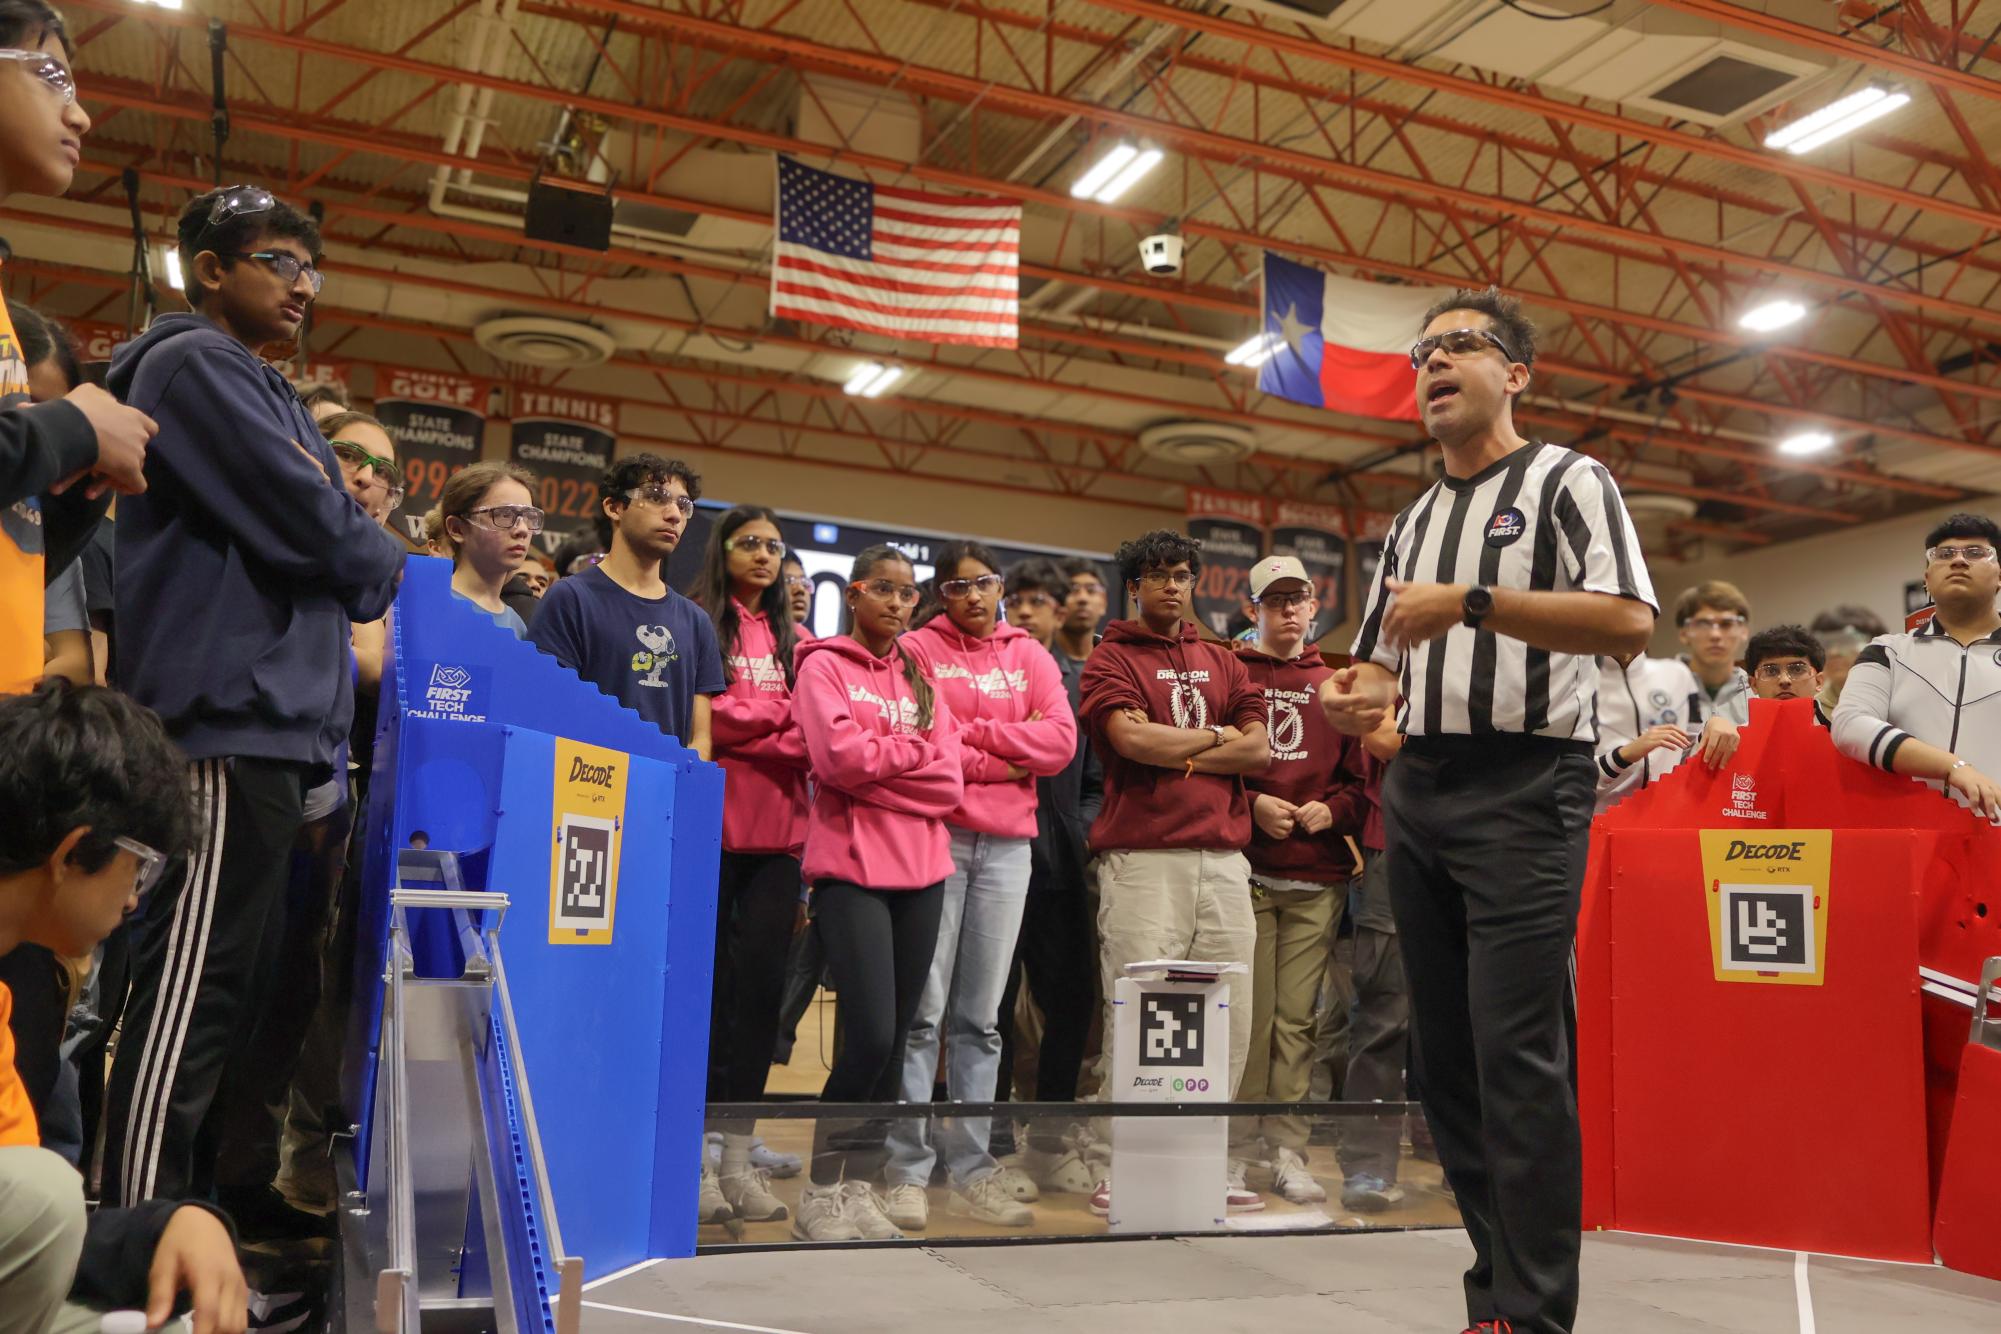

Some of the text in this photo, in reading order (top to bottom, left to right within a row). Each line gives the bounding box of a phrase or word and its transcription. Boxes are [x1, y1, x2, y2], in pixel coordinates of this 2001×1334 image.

[391, 379, 475, 404] GOLF
[521, 392, 613, 425] TENNIS
[408, 413, 451, 432] STATE
[544, 432, 584, 451] STATE
[518, 444, 606, 469] CHAMPIONS
[541, 476, 600, 519] 022
[426, 686, 472, 702] FIRST
[1265, 688, 1310, 701] RAGON
[428, 699, 465, 713] TECH
[568, 756, 616, 789] DECODE
[1731, 790, 1757, 801] FIRST
[1733, 800, 1754, 810] TECH
[1722, 808, 1767, 820] CHALLENGE
[1725, 840, 1806, 862] DECODE
[1133, 1076, 1165, 1087] DECODE
